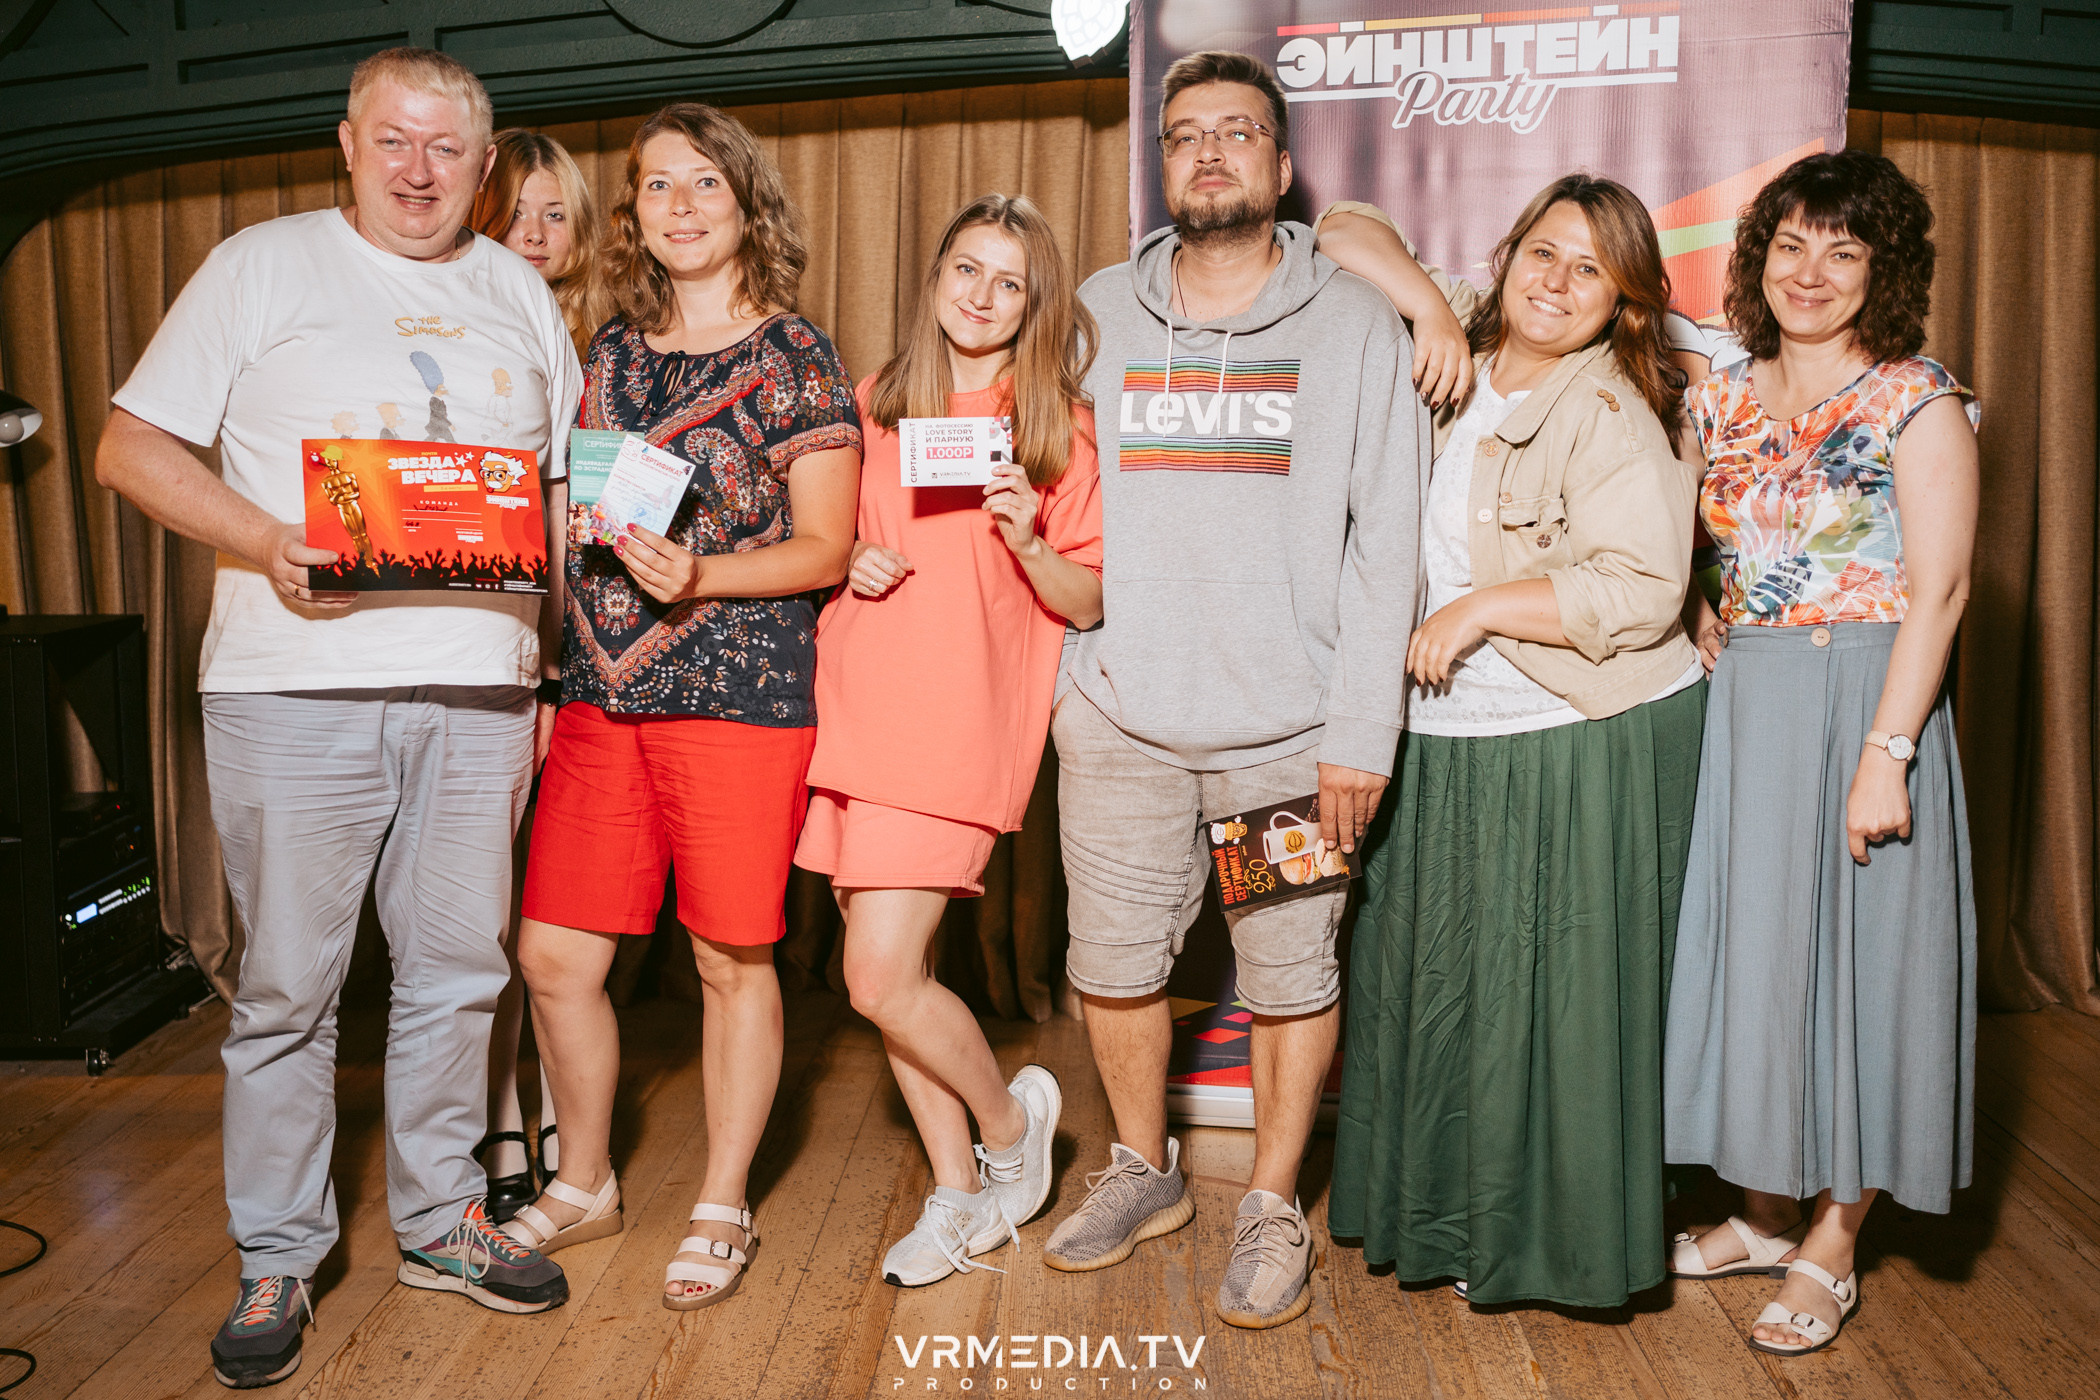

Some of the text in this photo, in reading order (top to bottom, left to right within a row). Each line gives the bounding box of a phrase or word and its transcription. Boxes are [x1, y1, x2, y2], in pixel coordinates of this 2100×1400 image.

[1277, 5, 1679, 88] ЭЙНШТЕЙН
[1392, 67, 1559, 134] Party
[909, 422, 918, 483] СЕРТИФИКАТ
[925, 428, 946, 436] LOVE
[387, 456, 456, 470] ЗВЕЗДА
[401, 469, 477, 484] ВЕЧЕРА
[640, 453, 684, 477] СЕРТИФИКАТ
[1211, 848, 1236, 905] ПОДАРОЧНЫЙ
[1226, 846, 1248, 902] СЕРТИФИКАТ
[1248, 858, 1273, 894] 250
